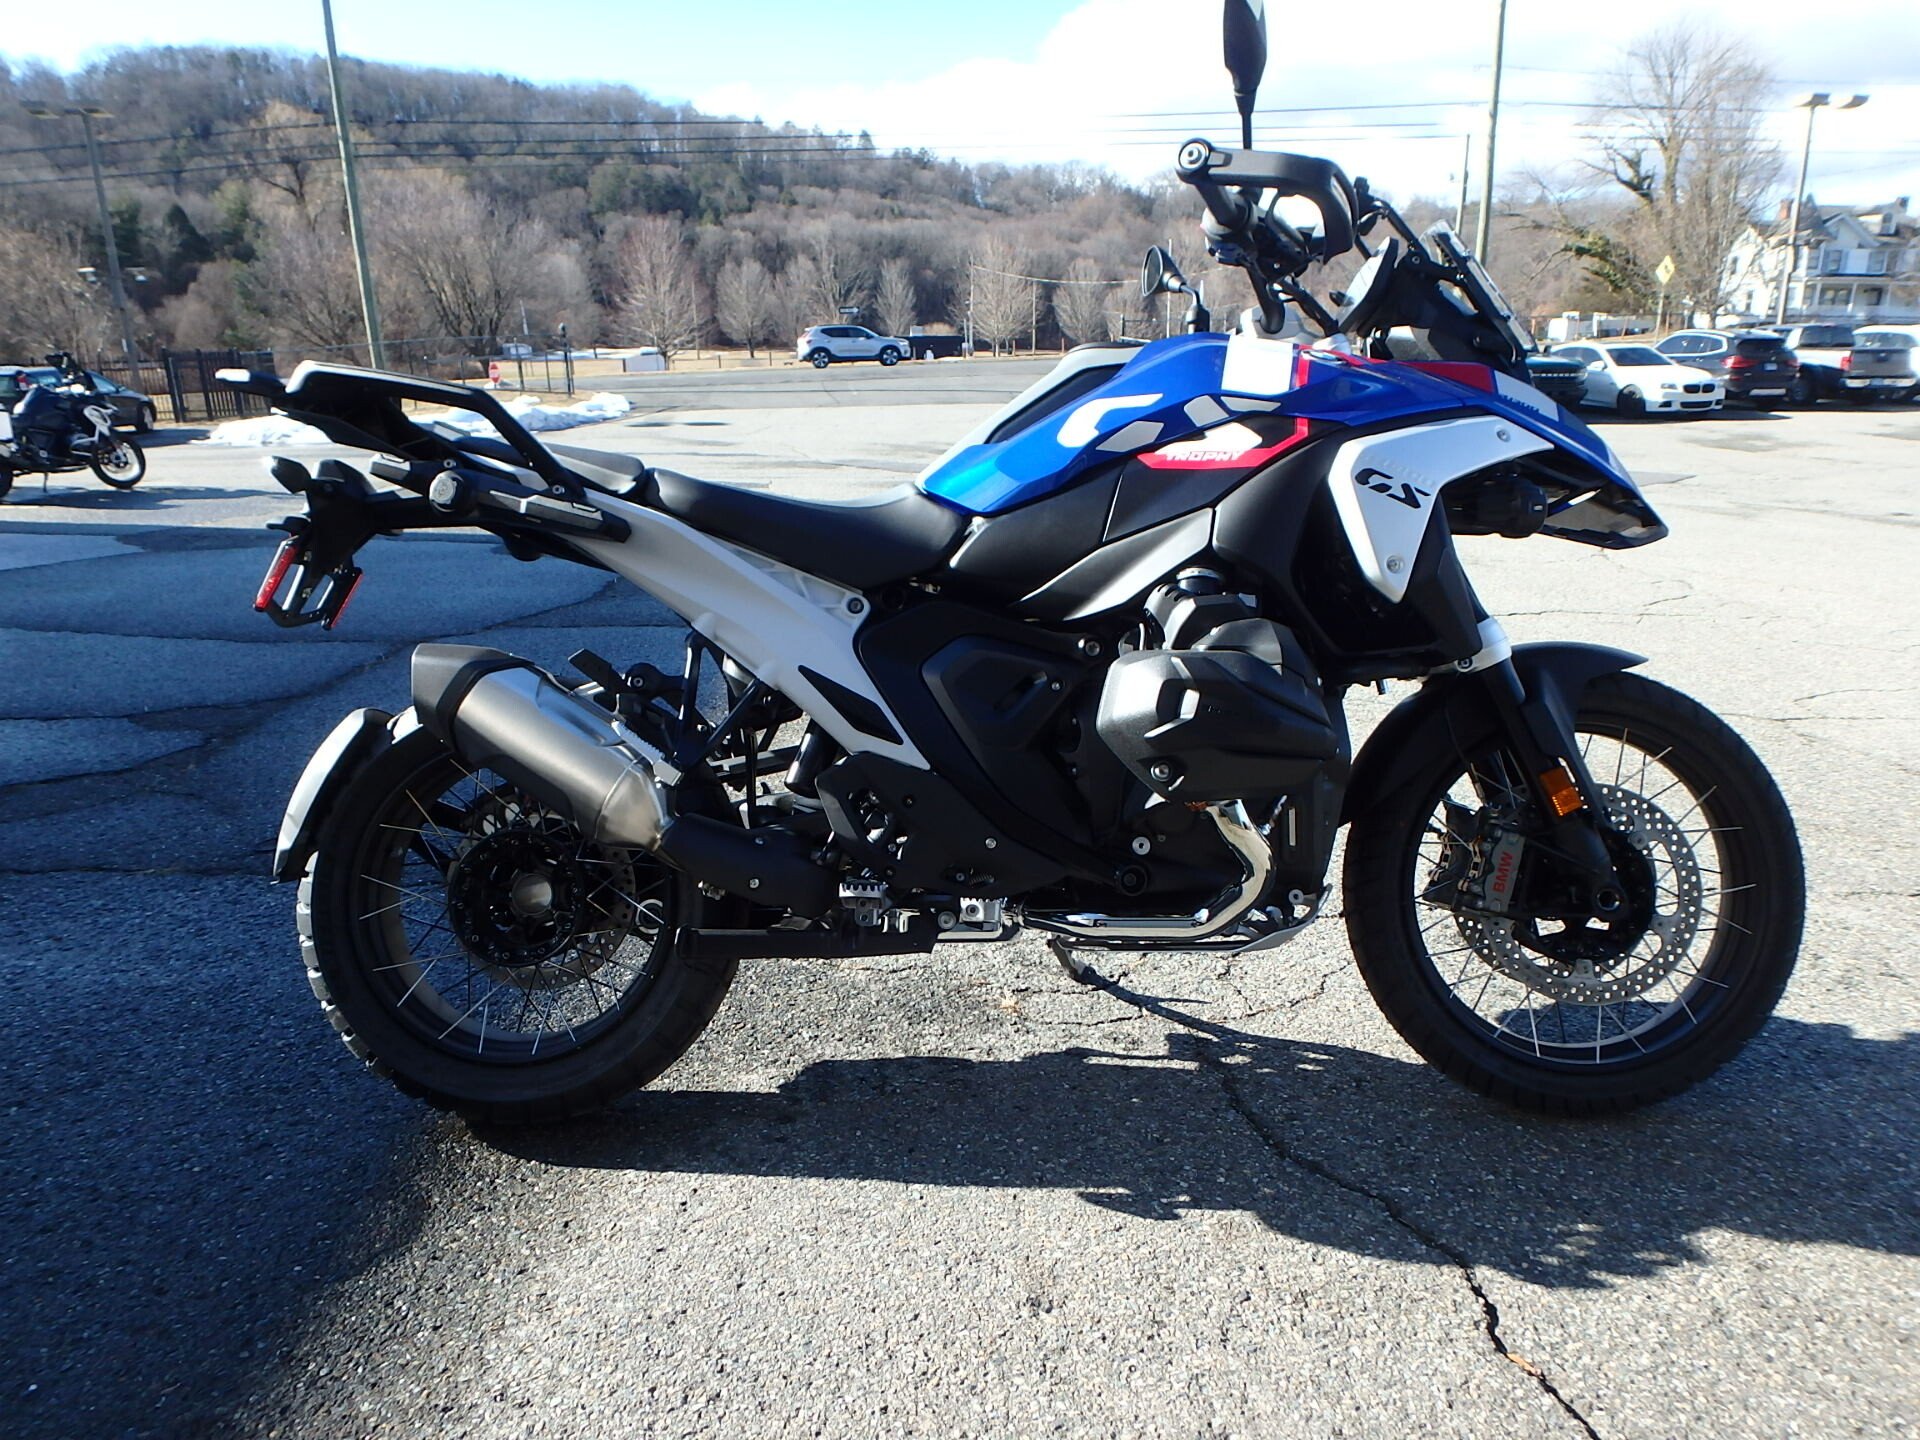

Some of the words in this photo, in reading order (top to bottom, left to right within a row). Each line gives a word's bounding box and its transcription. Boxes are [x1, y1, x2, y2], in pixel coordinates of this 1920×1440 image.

[1165, 450, 1243, 462] TROPHY
[1354, 467, 1431, 509] GS
[1492, 851, 1514, 893] BMW
